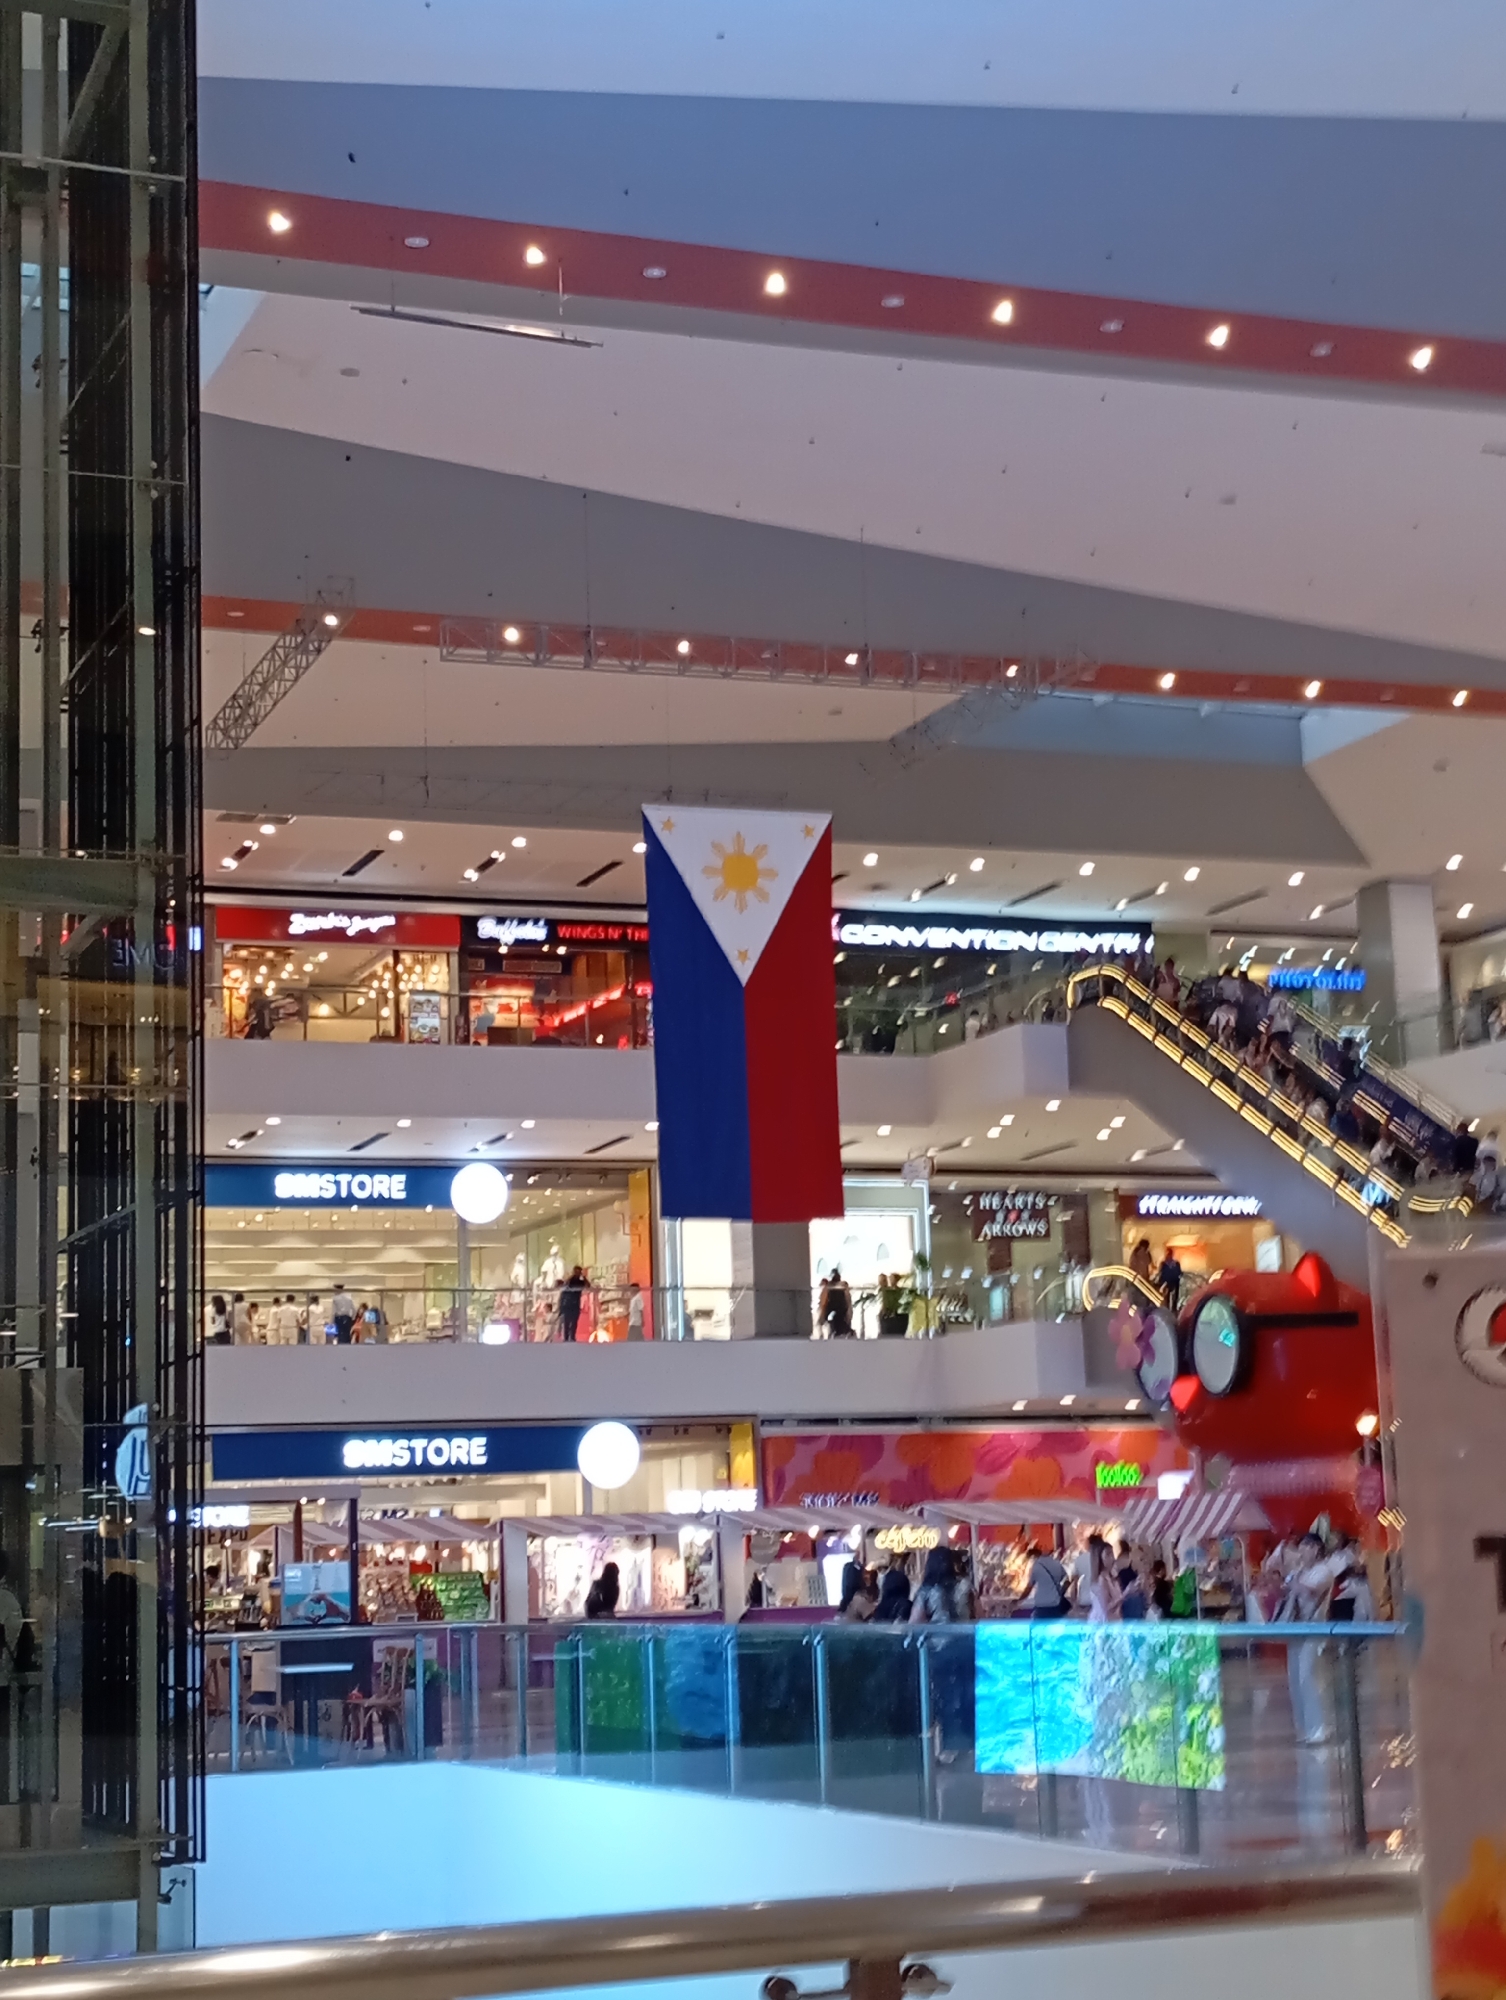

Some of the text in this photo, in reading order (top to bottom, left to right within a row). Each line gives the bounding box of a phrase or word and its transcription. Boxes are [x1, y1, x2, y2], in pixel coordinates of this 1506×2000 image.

[557, 924, 605, 940] WINGS
[840, 923, 1037, 952] CONVENTION
[320, 1174, 406, 1199] STORE
[979, 1191, 1047, 1210] HEARTS
[981, 1218, 1049, 1238] ARROWS
[391, 1437, 488, 1466] STORE
